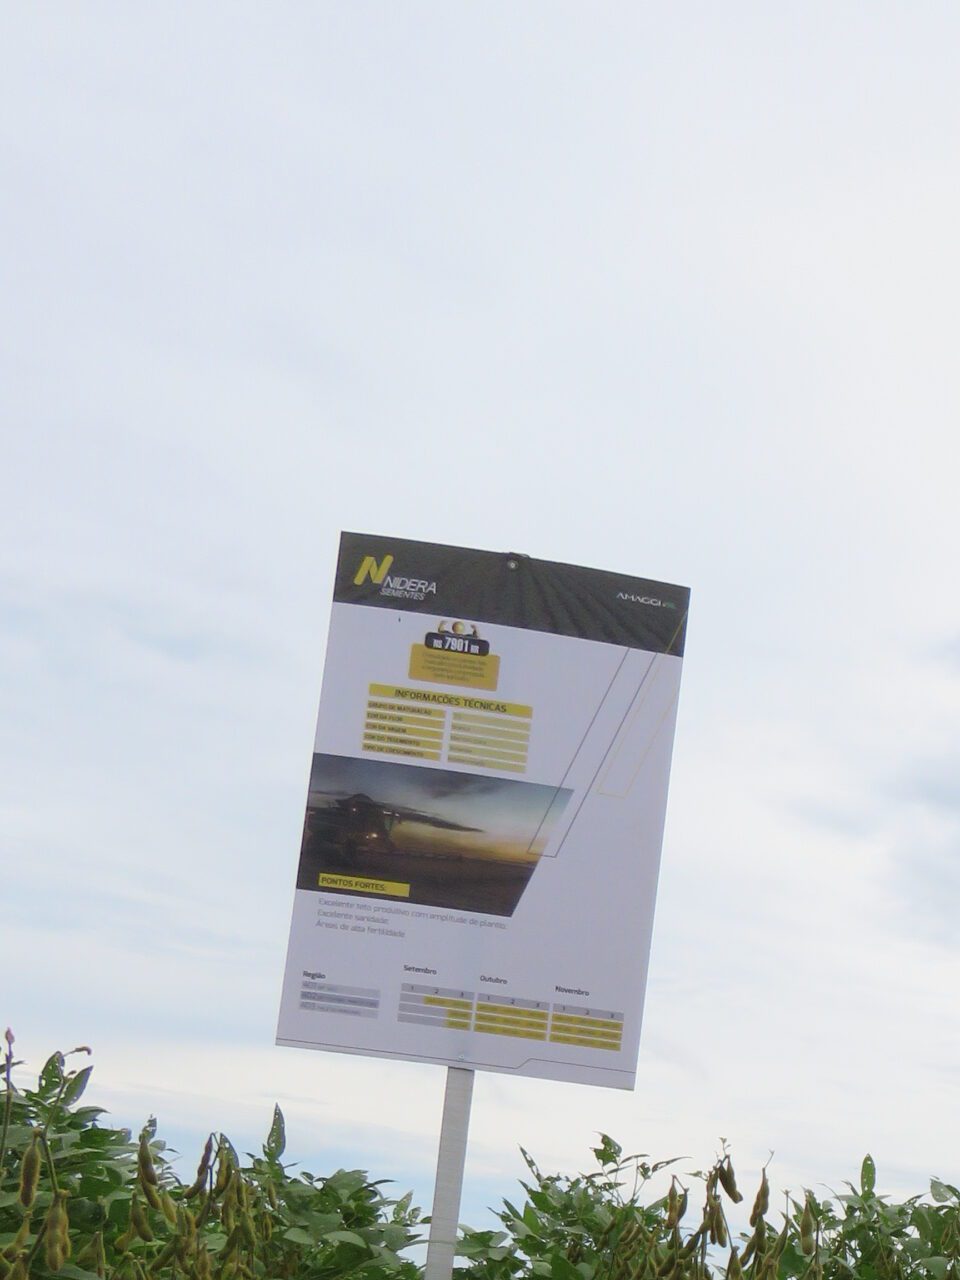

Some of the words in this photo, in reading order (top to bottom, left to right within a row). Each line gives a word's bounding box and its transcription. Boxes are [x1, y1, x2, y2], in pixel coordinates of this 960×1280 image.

[383, 576, 437, 594] NIDERA
[381, 587, 425, 600] SEMENTES
[616, 592, 661, 606] AMAGGI
[394, 689, 460, 706] INFORMAÇÕES
[463, 697, 507, 713] TÉCNICAS
[321, 877, 352, 887] PONTOS
[317, 909, 354, 920] Excelente
[318, 898, 354, 909] Excelente
[373, 906, 409, 917] produtivo
[429, 912, 467, 924] amplitude
[303, 970, 326, 980] Região
[403, 964, 437, 975] Setembro
[479, 975, 508, 985] Outubro
[555, 986, 590, 997] Novembro
